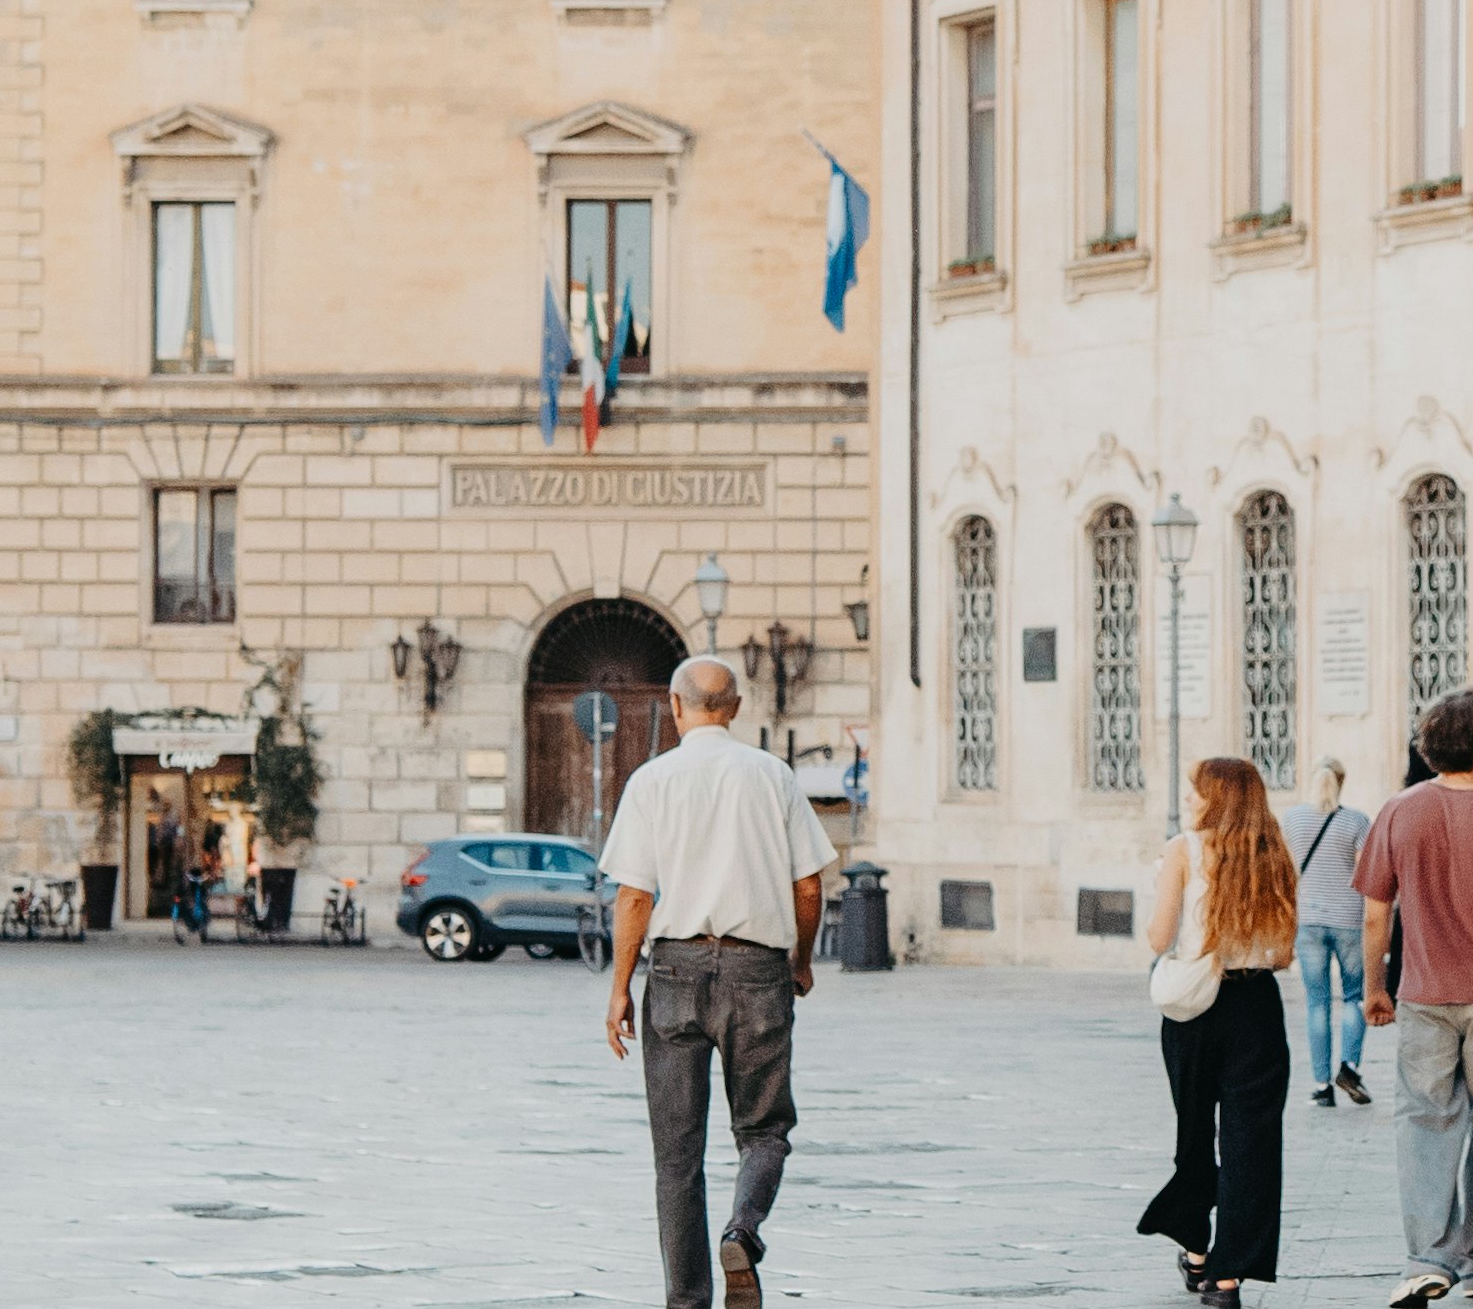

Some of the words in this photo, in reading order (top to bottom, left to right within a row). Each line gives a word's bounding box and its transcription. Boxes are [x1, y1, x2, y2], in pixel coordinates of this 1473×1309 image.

[454, 470, 584, 506] PALAZZO
[592, 470, 619, 506] DI
[625, 470, 762, 506] GIUSTIZIA
